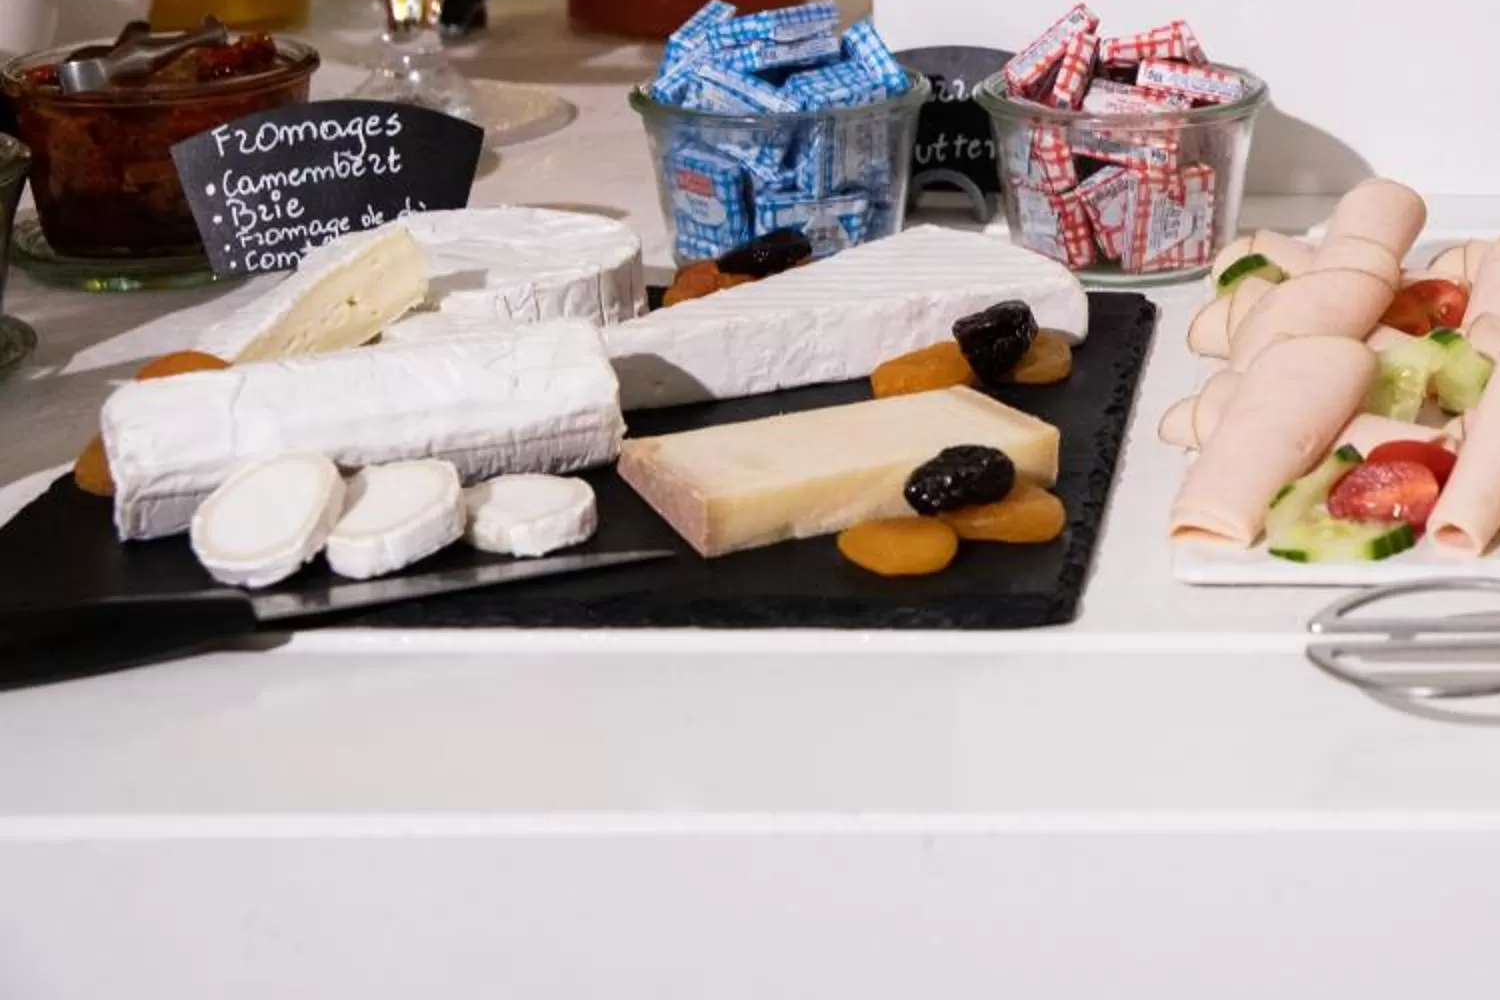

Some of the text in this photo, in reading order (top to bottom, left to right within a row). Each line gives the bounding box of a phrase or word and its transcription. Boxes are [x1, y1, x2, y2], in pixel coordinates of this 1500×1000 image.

[211, 113, 402, 160] Fromages
[915, 132, 996, 164] utter
[222, 146, 403, 197] Camembert
[225, 190, 305, 231] Brie
[235, 215, 351, 248] Fromage
[360, 203, 385, 228] de
